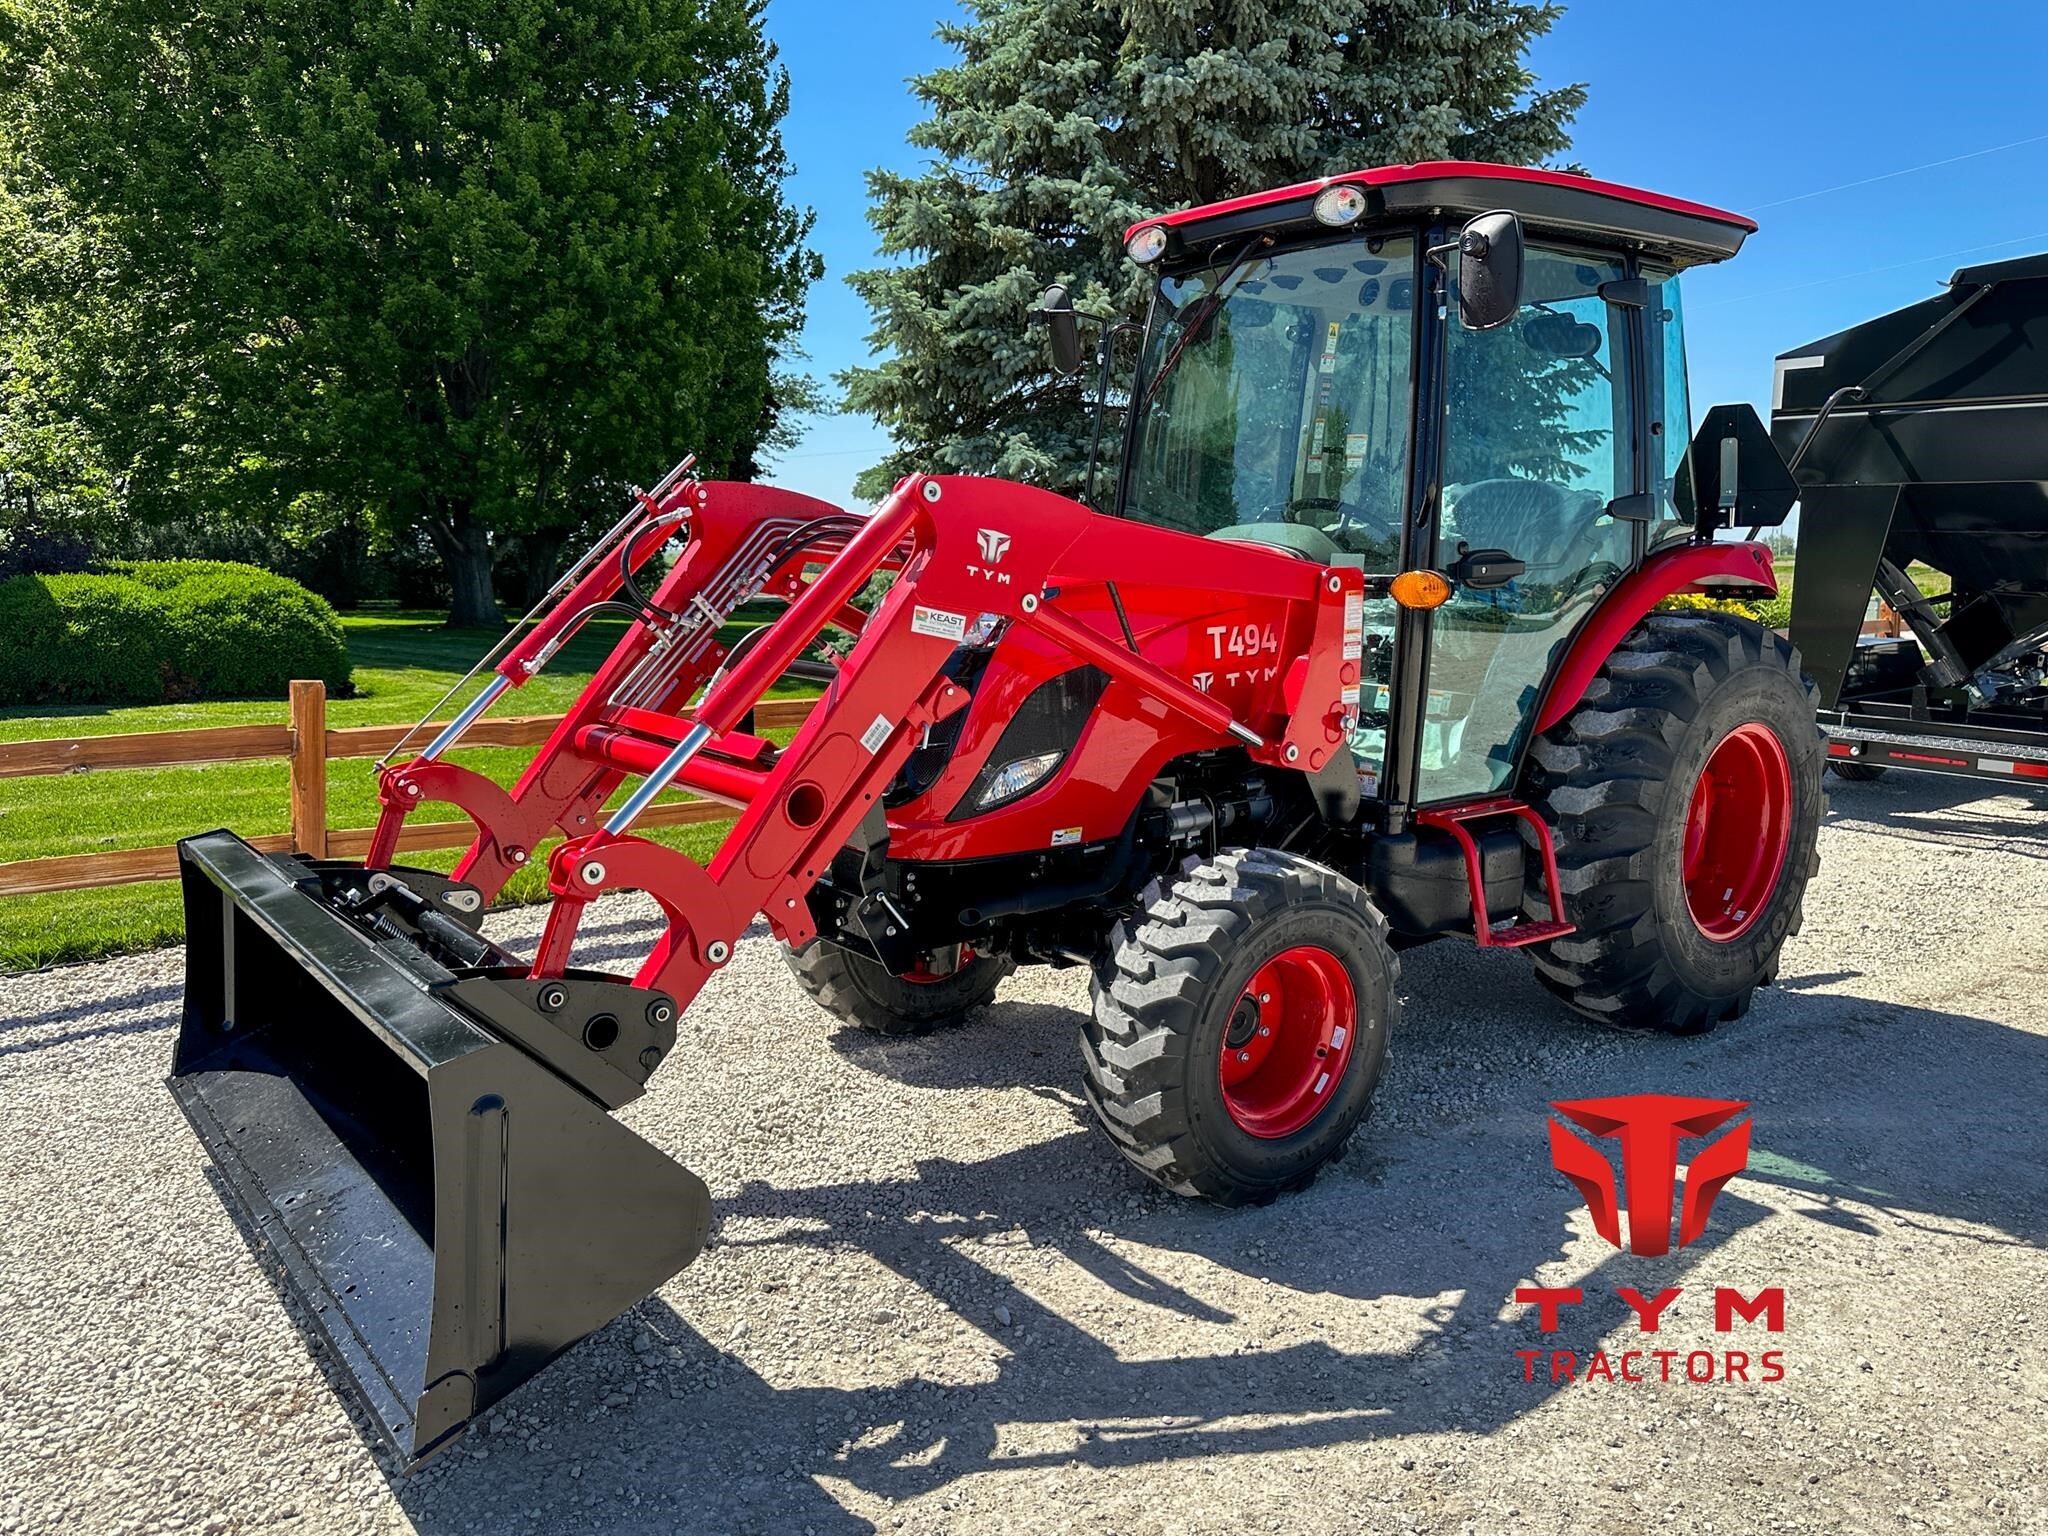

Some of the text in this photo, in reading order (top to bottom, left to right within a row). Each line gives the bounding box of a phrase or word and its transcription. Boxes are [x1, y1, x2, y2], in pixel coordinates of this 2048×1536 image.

[966, 564, 1011, 585] TYM
[929, 612, 965, 626] KEAST
[1206, 624, 1277, 659] T494
[1225, 666, 1277, 687] TYM
